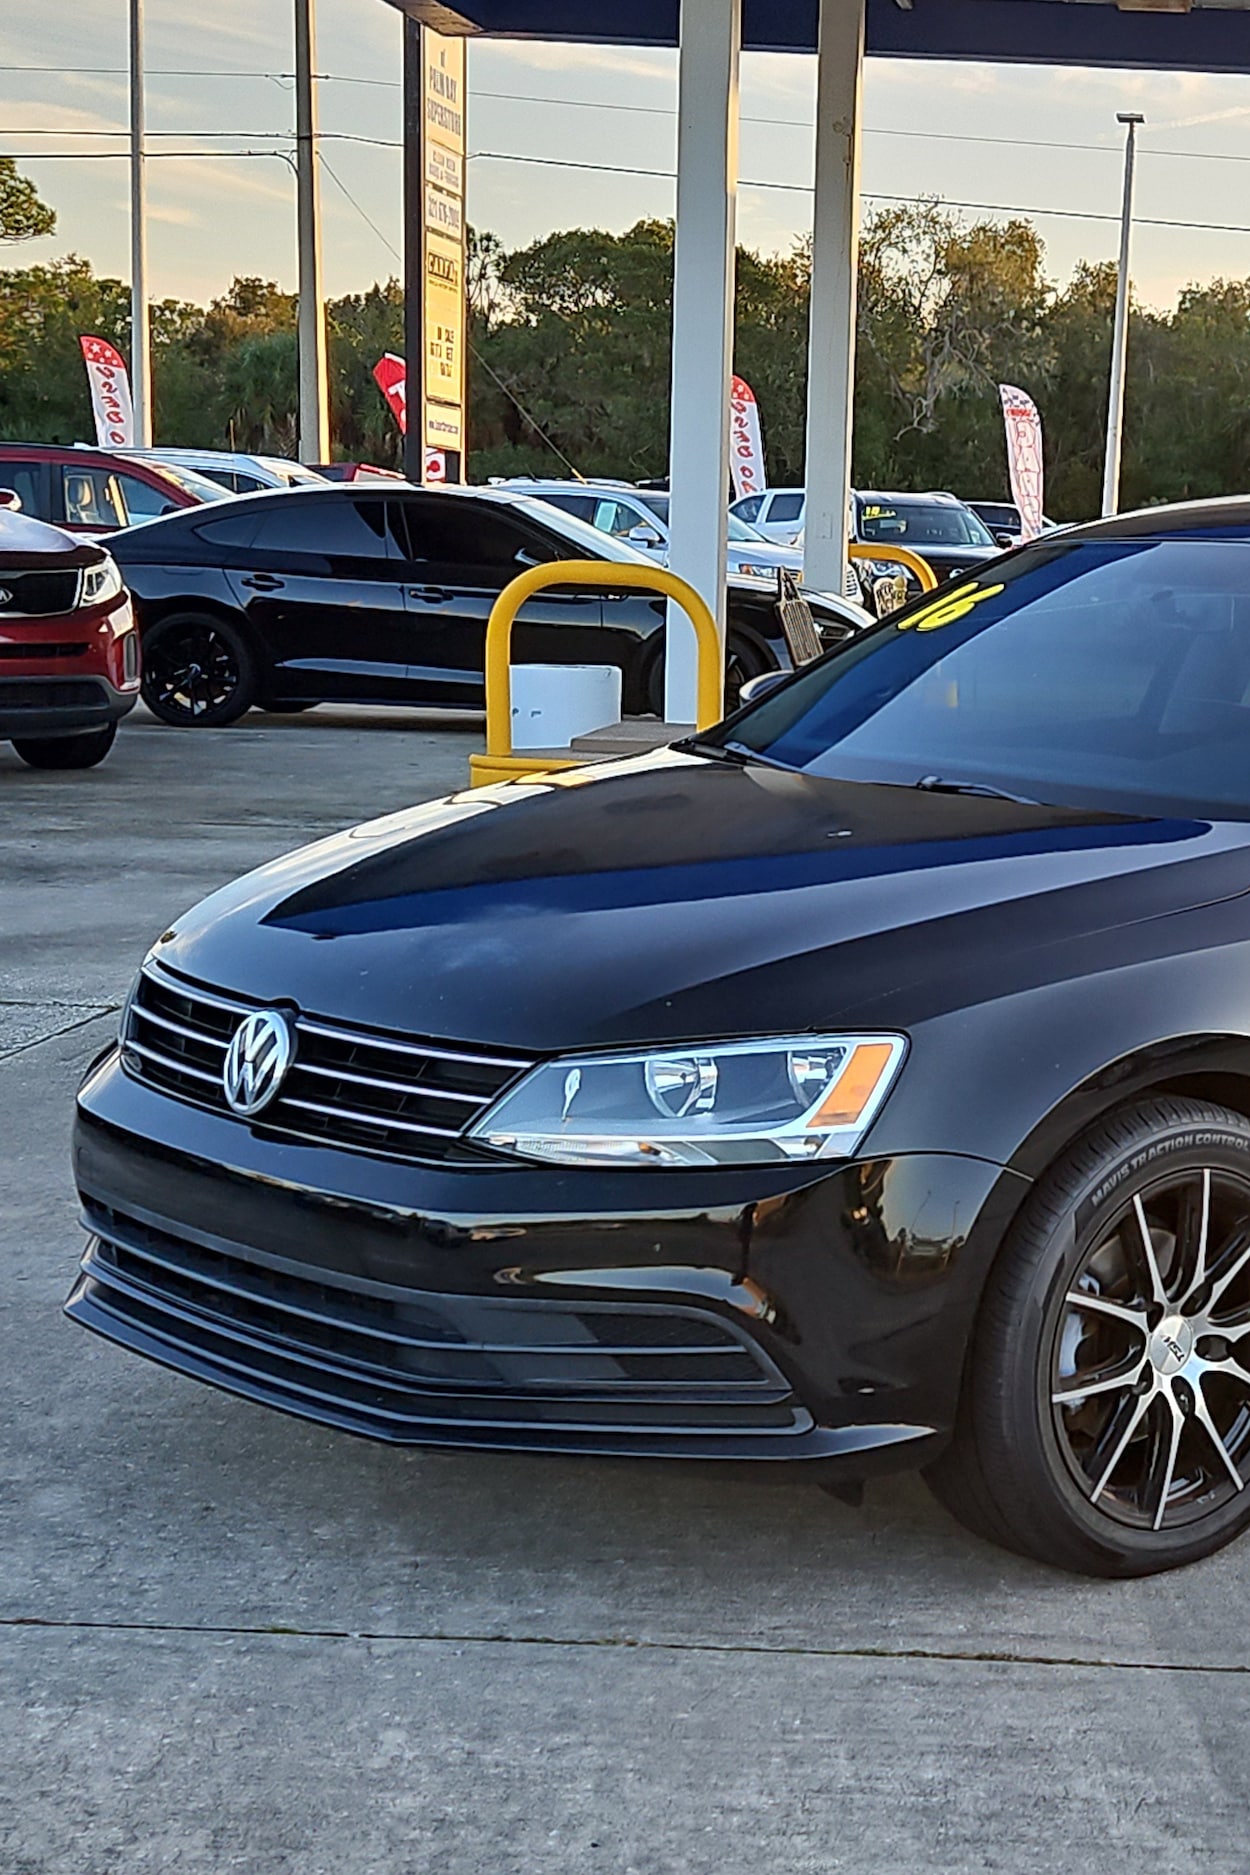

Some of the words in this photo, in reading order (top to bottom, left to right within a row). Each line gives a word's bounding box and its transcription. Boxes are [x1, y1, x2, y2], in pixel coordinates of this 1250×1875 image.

[427, 97, 461, 137] SUPERSTORE
[896, 580, 1006, 632] 16
[1091, 1163, 1130, 1207] MAVIS
[1130, 1134, 1193, 1169] TRACTION
[1195, 1132, 1250, 1153] CONTROL
